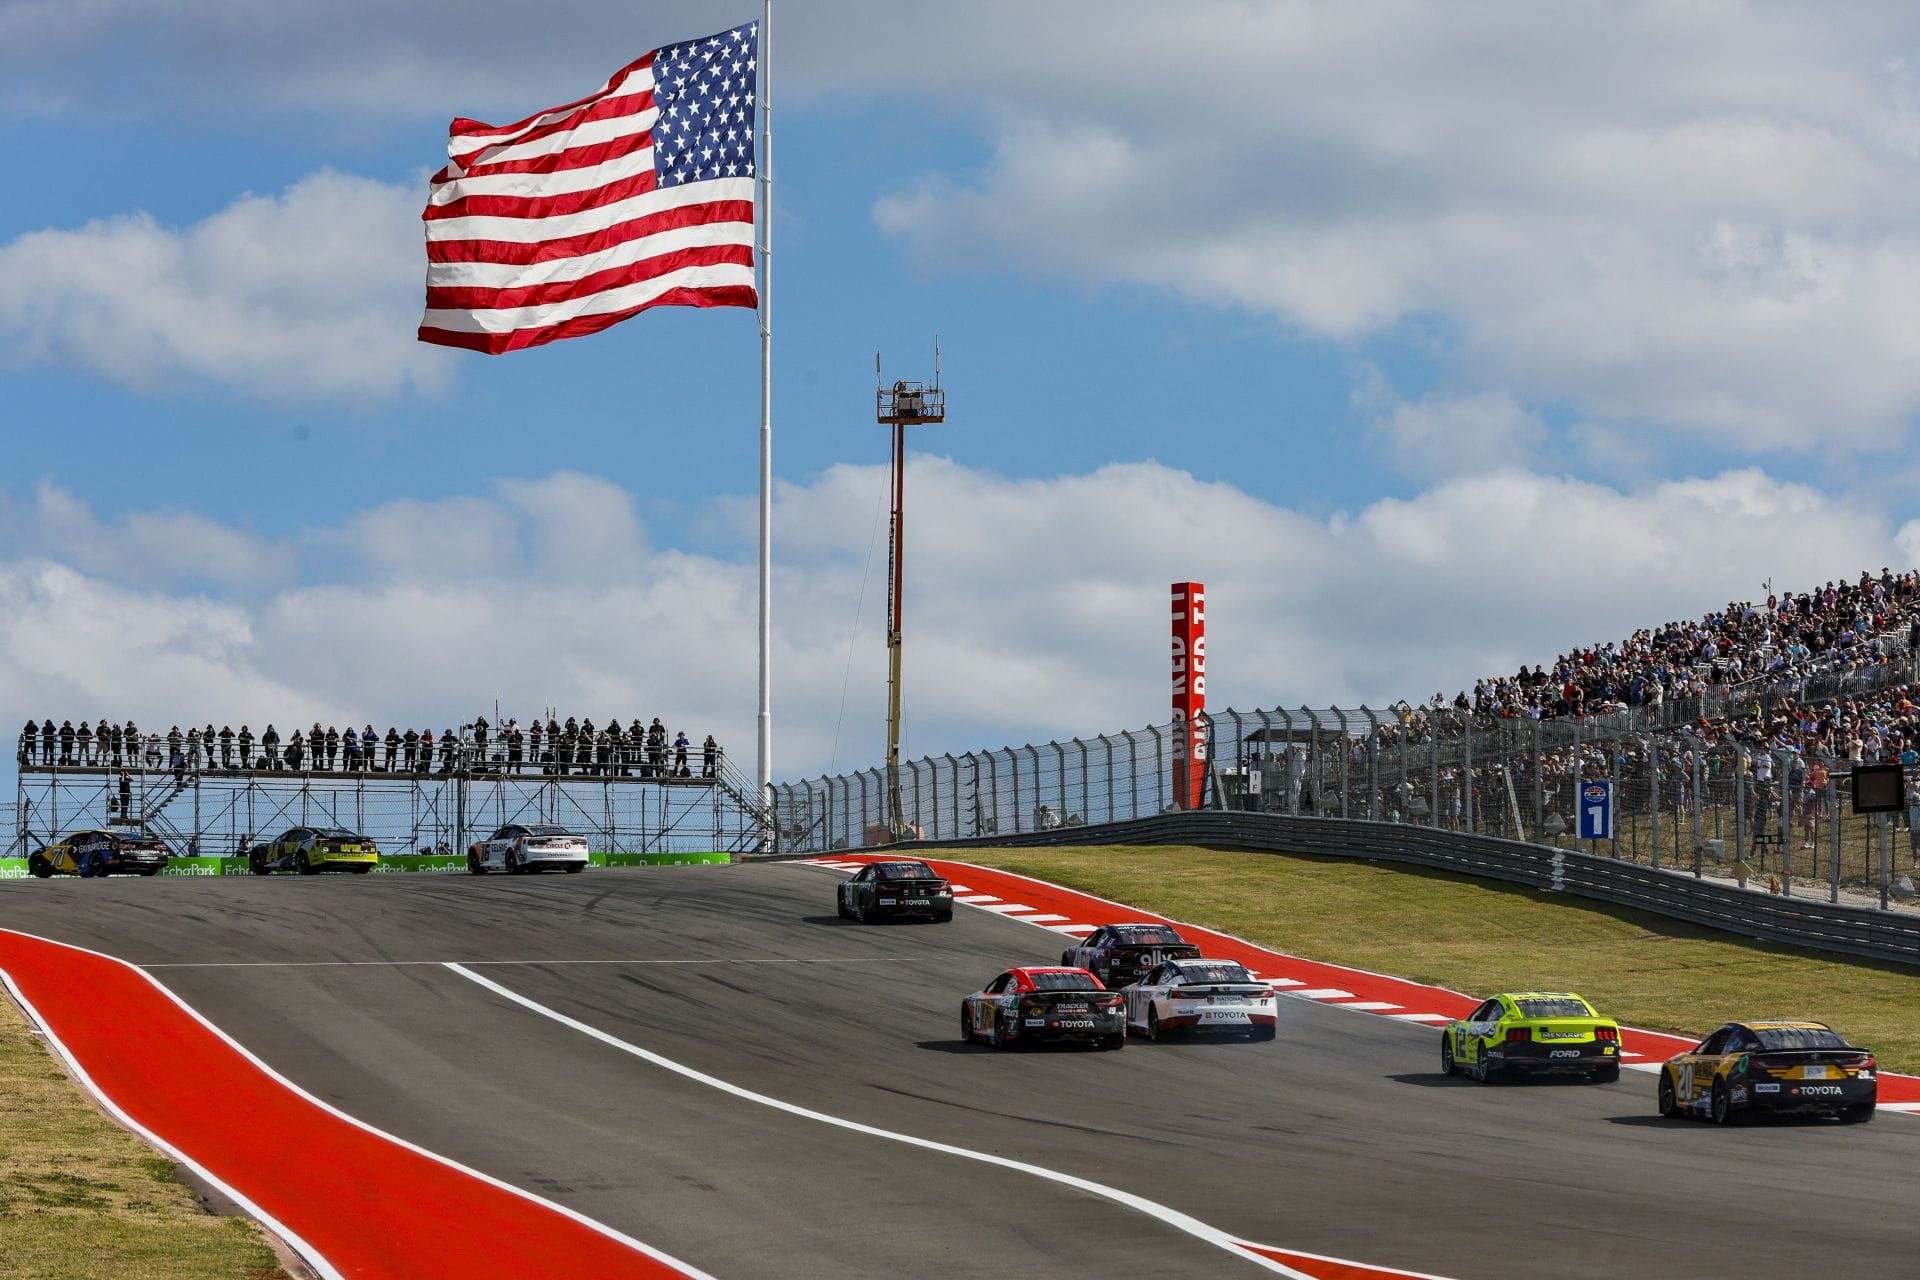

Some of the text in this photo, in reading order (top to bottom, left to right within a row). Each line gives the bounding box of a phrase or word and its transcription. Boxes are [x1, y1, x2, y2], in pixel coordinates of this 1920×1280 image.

[1588, 806, 1603, 835] 1
[50, 847, 65, 866] 71
[1140, 948, 1172, 966] ally
[1061, 1020, 1095, 1028] TOYOTA
[1549, 1050, 1580, 1058] FORD
[1603, 1046, 1615, 1055] 12
[1678, 1063, 1693, 1100] 20
[1800, 1086, 1843, 1095] TOYOTA
